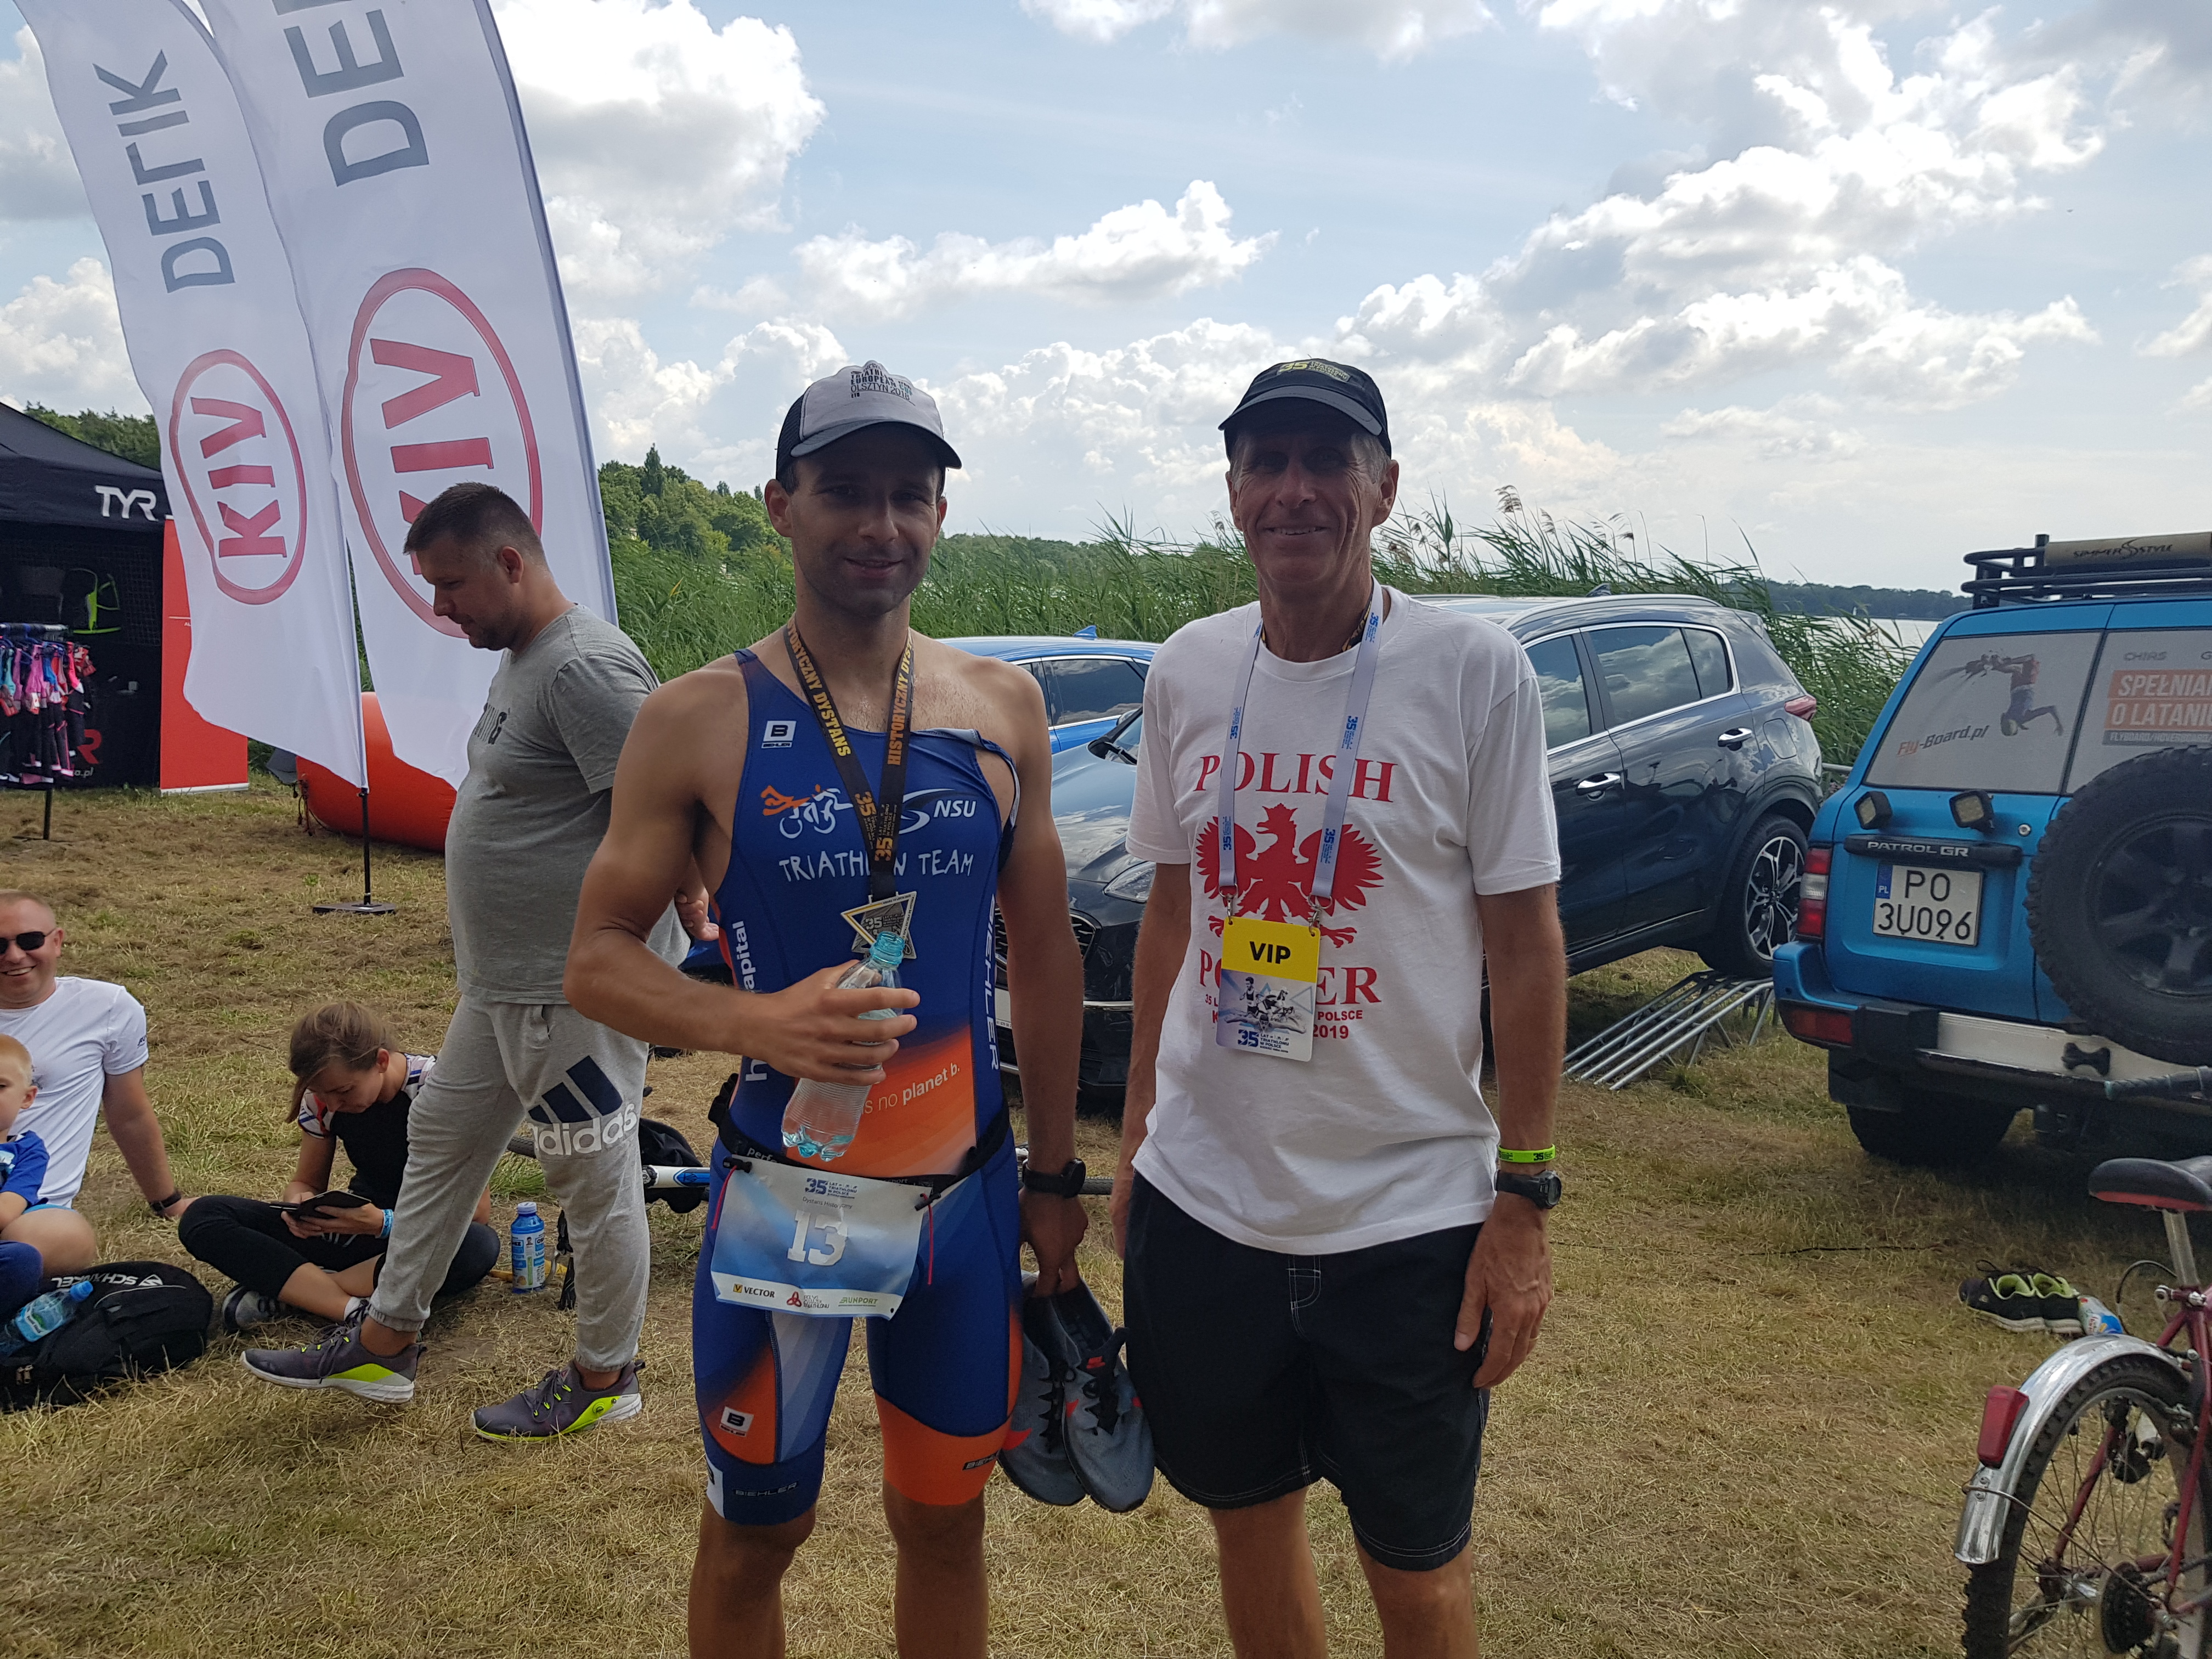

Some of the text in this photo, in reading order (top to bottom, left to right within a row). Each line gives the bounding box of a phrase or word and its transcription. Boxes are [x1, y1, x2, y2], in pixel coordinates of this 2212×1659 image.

[851, 383, 888, 392] OLSZTYN
[94, 485, 159, 521] TYR
[887, 673, 909, 765] HISTORYCZNY
[1346, 715, 1358, 730] 35
[2112, 703, 2126, 726] O
[771, 725, 788, 737] B
[813, 692, 851, 757] DYSTANS
[855, 792, 877, 816] 35
[933, 800, 977, 818] NSU
[1223, 836, 1232, 850] 35
[1324, 828, 1335, 843] 35
[874, 837, 893, 861] 35
[1867, 842, 1969, 857] PATROL GR
[779, 849, 974, 882] TRIATHLN TEAM
[1878, 885, 1889, 894] PL
[1905, 870, 1951, 901] PO
[865, 917, 882, 929] 35
[1877, 902, 1973, 940] 3U096
[732, 921, 756, 992] apital
[1250, 941, 1290, 964] VIP
[984, 894, 1000, 1070] BIEHLER
[1199, 949, 1381, 1005] PER
[1205, 994, 1212, 1005] 35
[1318, 1010, 1363, 1021] POLSCE
[1238, 1029, 1259, 1047] 35
[1313, 1024, 1348, 1039] 2019
[879, 1094, 898, 1111] no
[902, 1068, 948, 1105] planet
[950, 1063, 960, 1077] b.
[1533, 1153, 1544, 1161] 35
[805, 1178, 828, 1194] 35
[803, 1197, 822, 1206] Dystans
[787, 1211, 848, 1266] 13
[744, 1287, 775, 1298] VECTOR
[727, 1412, 744, 1426] B
[736, 1482, 797, 1496] BIEHLER
